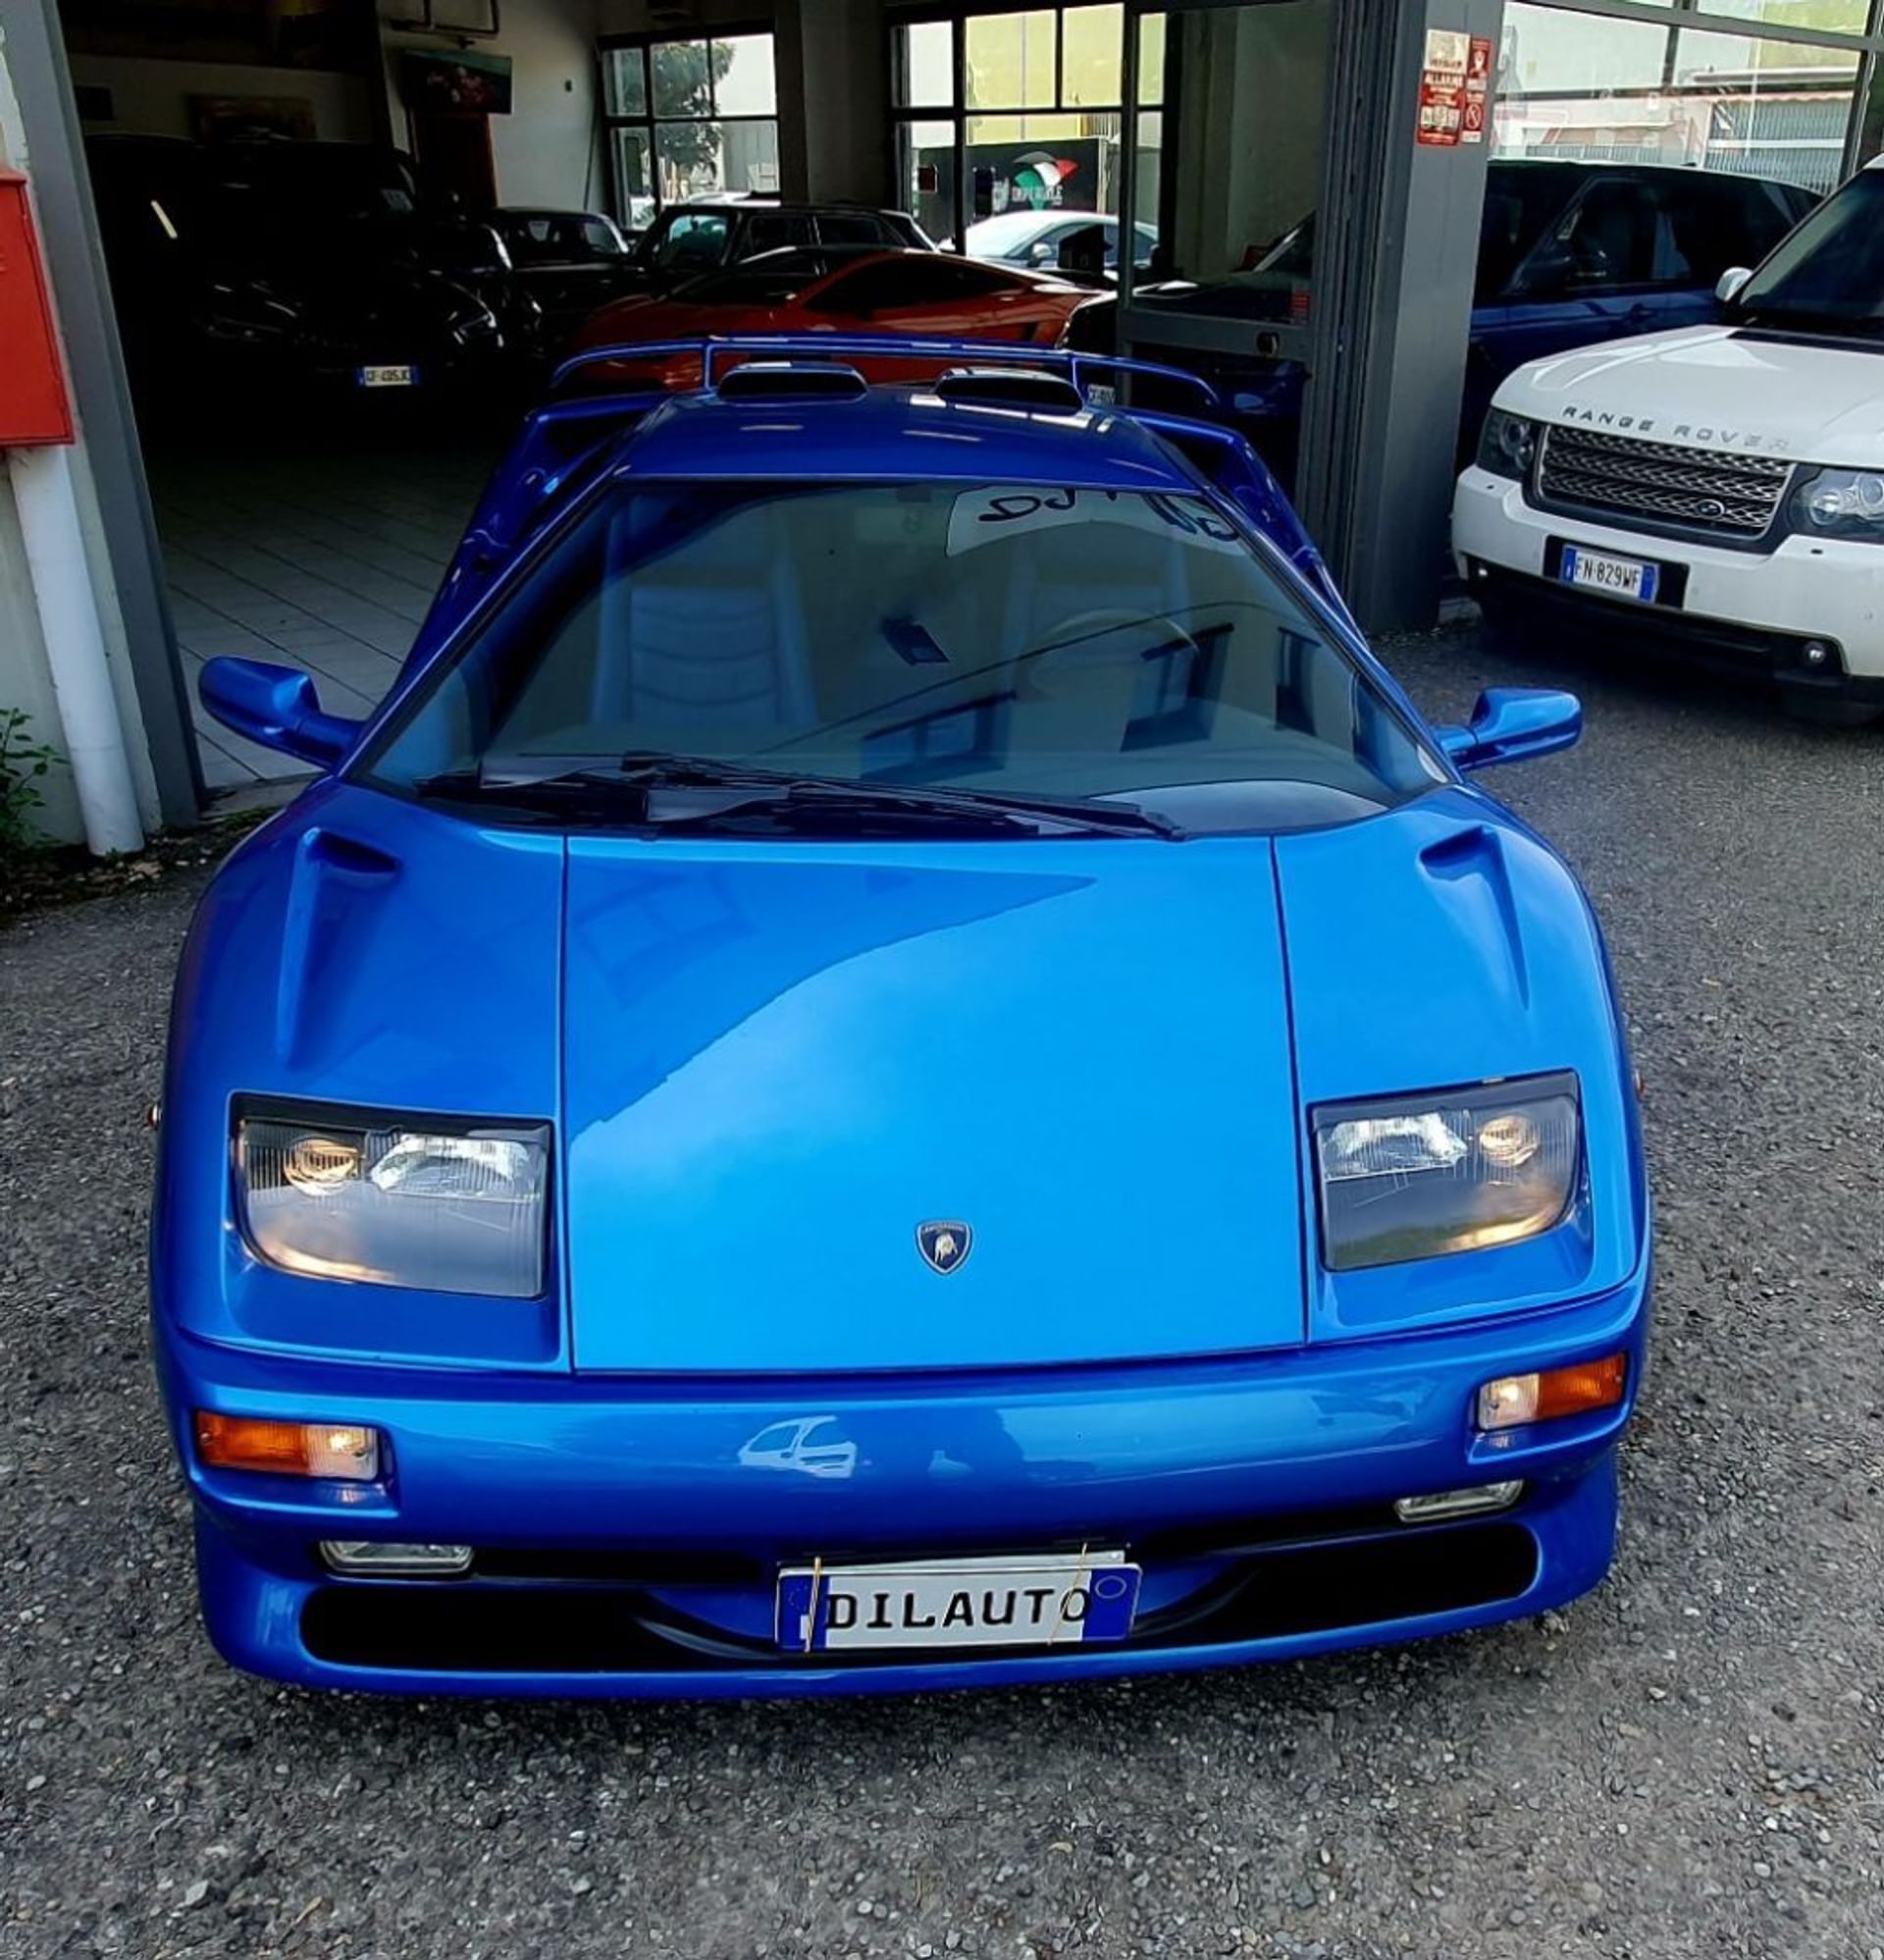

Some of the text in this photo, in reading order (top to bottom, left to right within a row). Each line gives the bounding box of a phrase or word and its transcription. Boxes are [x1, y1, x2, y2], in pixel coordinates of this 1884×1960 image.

[1562, 406, 1790, 450] RANGE ROVER
[825, 1588, 1091, 1629] DILAUTO
